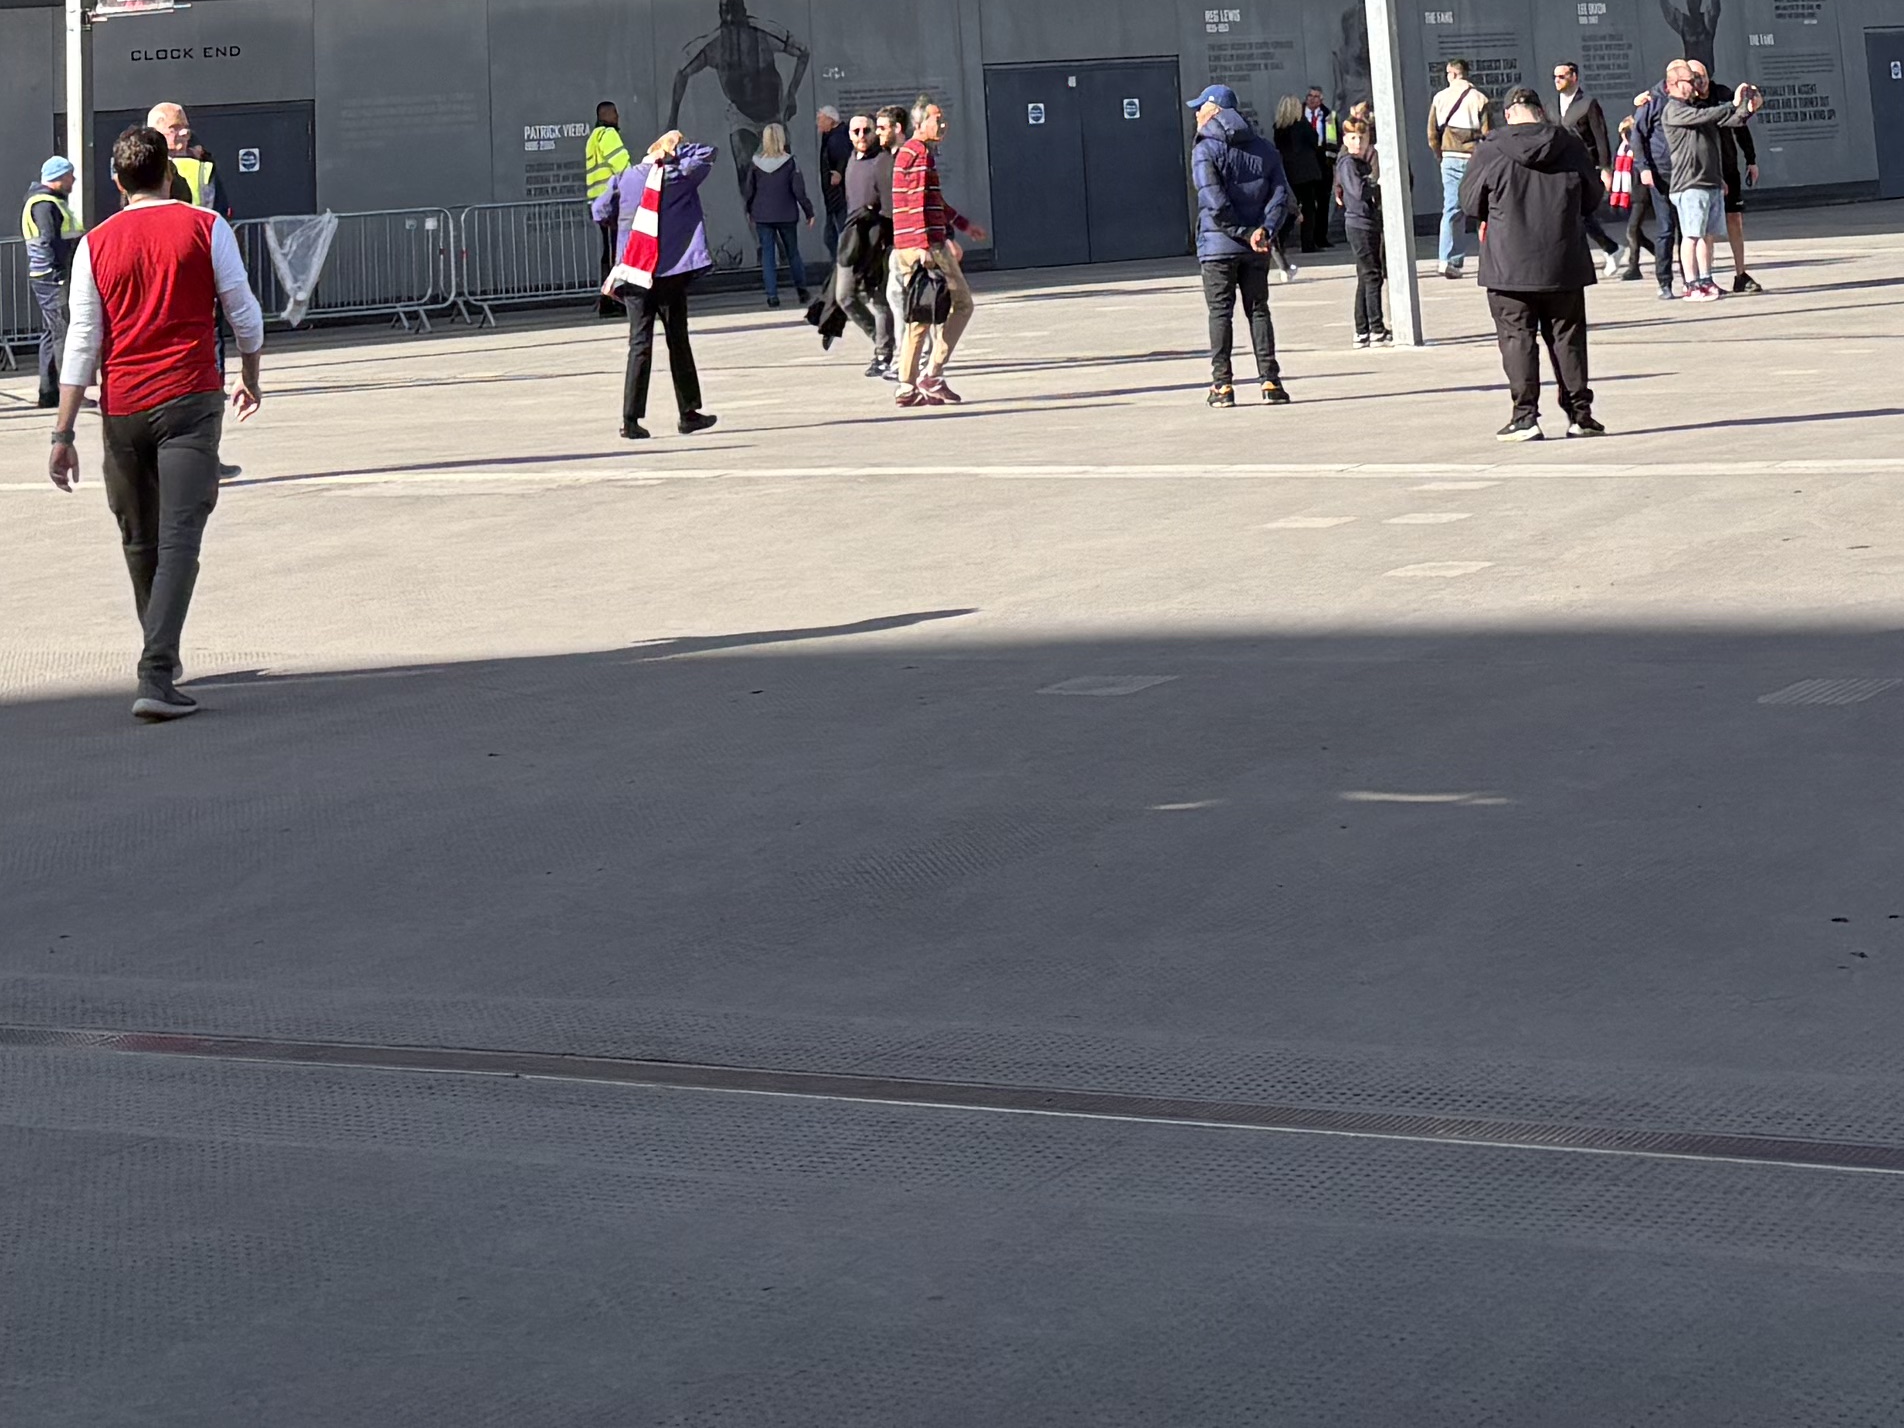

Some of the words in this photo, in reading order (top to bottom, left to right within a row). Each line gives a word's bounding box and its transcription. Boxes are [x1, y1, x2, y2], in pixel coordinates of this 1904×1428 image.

[130, 47, 194, 61] CLOCK
[203, 45, 241, 58] END
[524, 125, 562, 140] PATRICK
